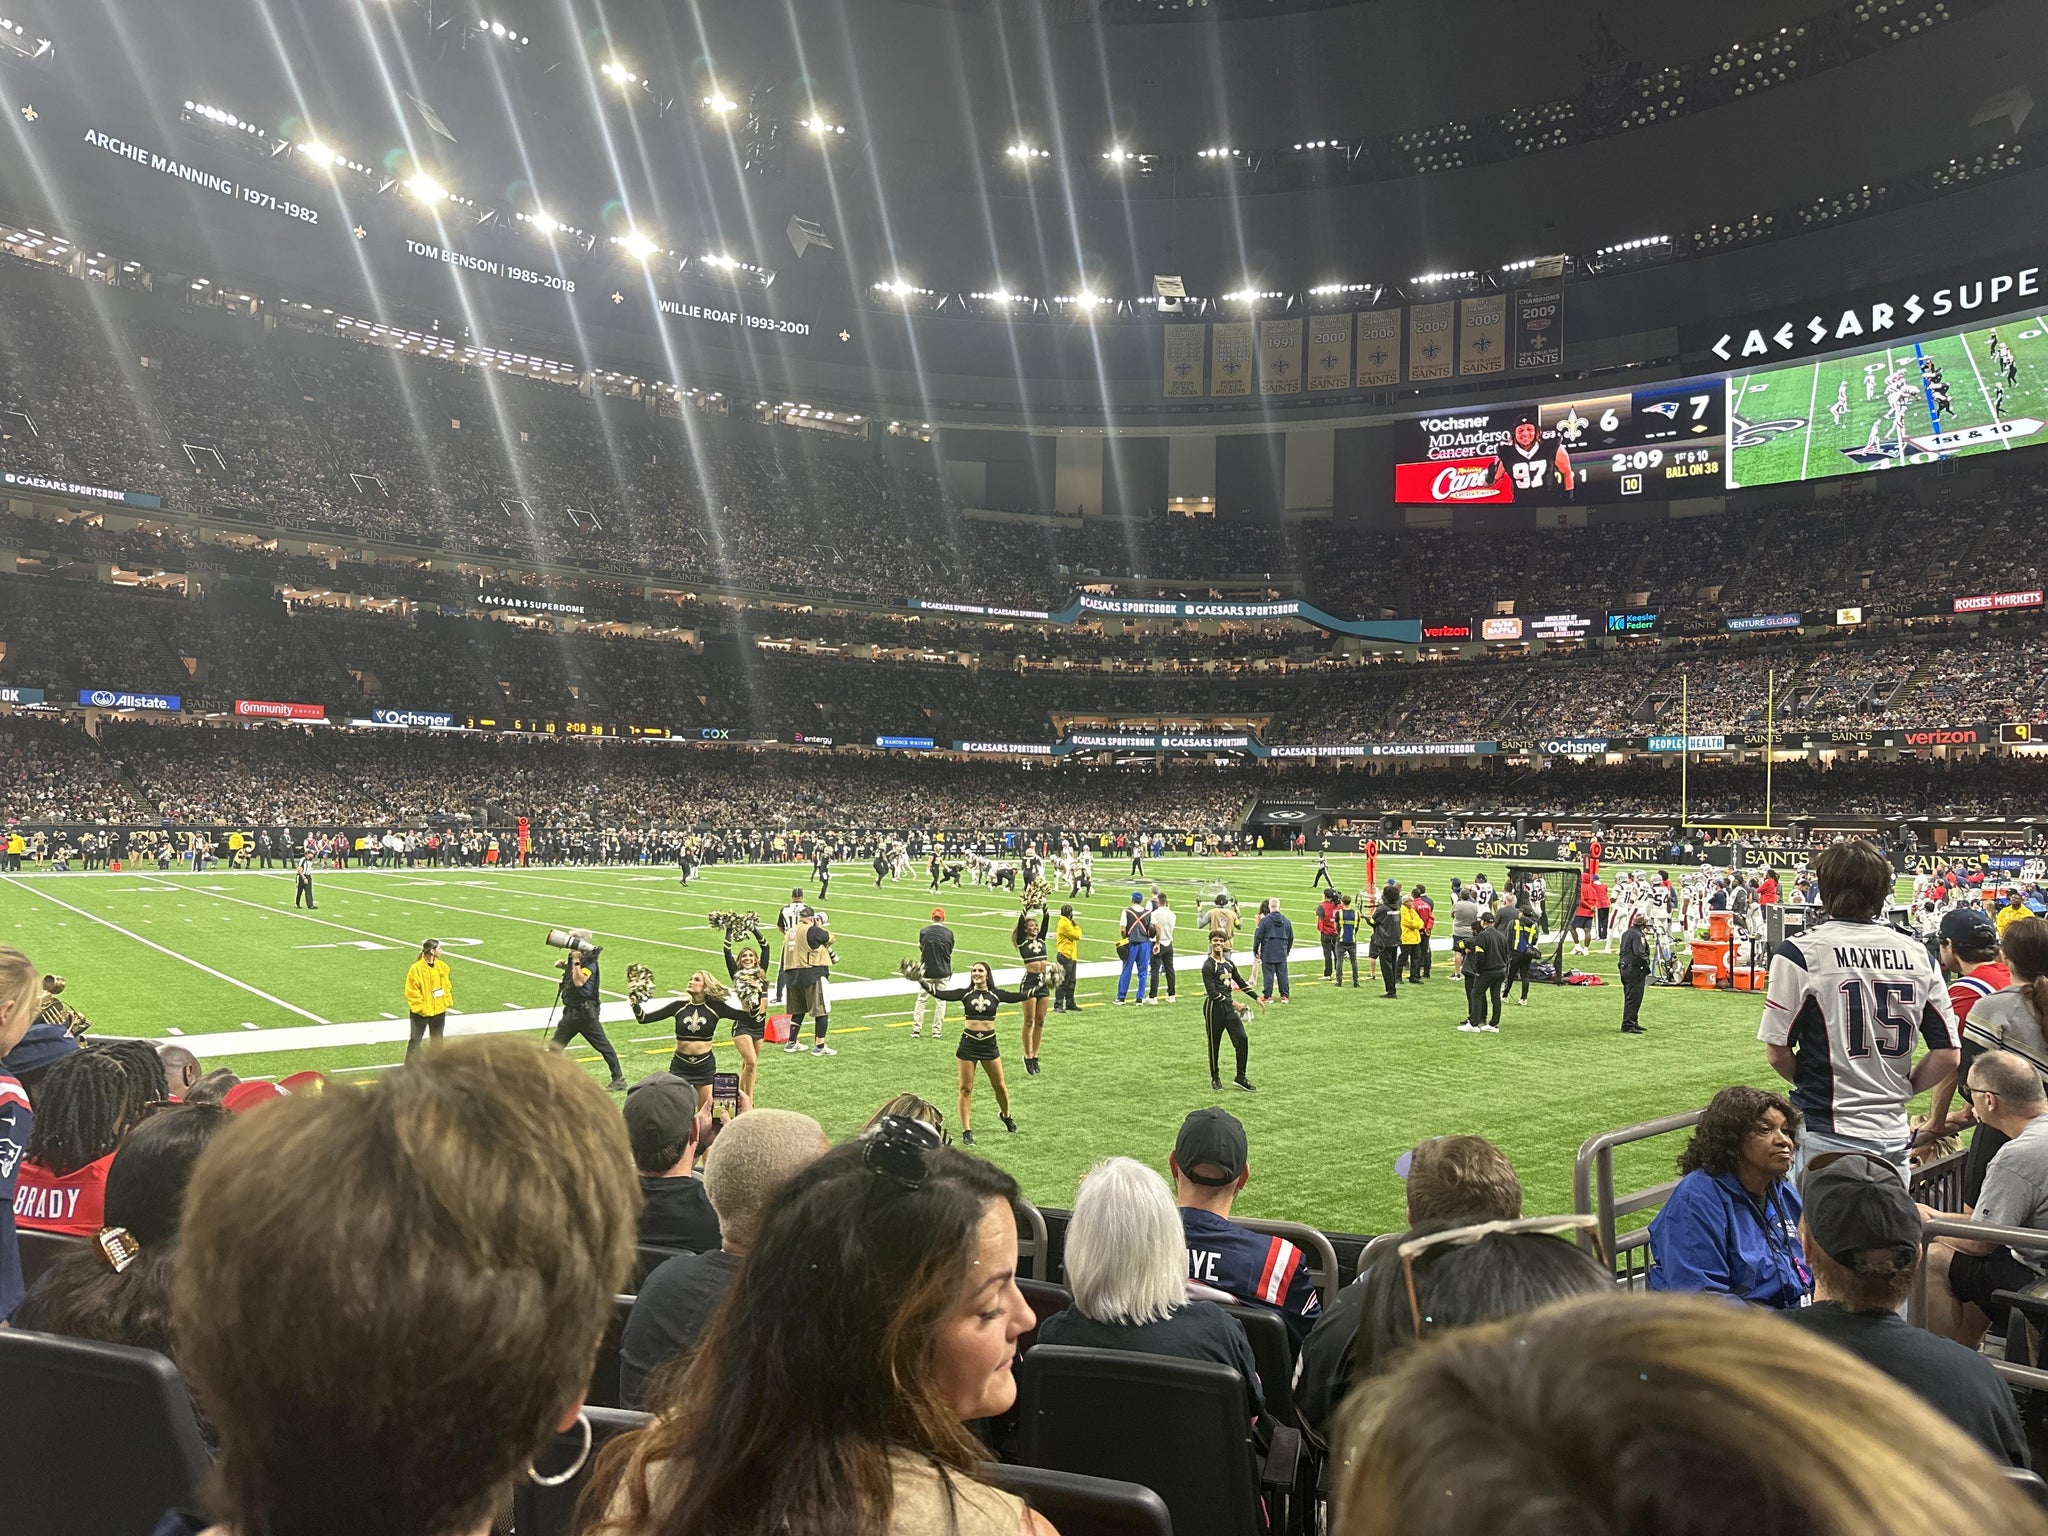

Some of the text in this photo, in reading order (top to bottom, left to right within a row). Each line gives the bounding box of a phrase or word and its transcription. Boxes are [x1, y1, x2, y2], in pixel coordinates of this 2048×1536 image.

[84, 128, 319, 225] ARCHIE MANNING 1971-1982
[406, 240, 576, 293] TOM BENSON 1985-2018
[1519, 294, 1560, 305] CHAMPIONS
[658, 299, 810, 336] WILLIE ROAF 1993-2001
[1522, 305, 1556, 319] 2009
[1711, 267, 2039, 361] CAESARS SUPE
[1416, 320, 1448, 333] 2009
[1467, 313, 1500, 327] 2009
[1314, 332, 1346, 344] 2000
[1363, 328, 1395, 340] 2006
[1268, 337, 1295, 349] 1991
[1518, 353, 1559, 367] SAINTS
[1412, 367, 1450, 379] SAINTS
[1462, 361, 1502, 374] SAINTS
[1310, 378, 1347, 389] SAINTS
[1360, 374, 1397, 386] SAINTS
[1262, 383, 1299, 393] SAINTS
[1690, 395, 1710, 420] 7
[1429, 416, 1490, 431] Ochsner
[1600, 408, 1619, 432] 6
[1429, 430, 1511, 448] MD Anderso
[1931, 424, 2012, 445] 1st & 10
[1427, 446, 1475, 460] Cancer
[1674, 450, 1709, 464] 1ST & 10
[1611, 449, 1664, 472] 2:09
[1512, 459, 1547, 489] 97
[1665, 462, 1719, 479] BALL ON 38
[16, 475, 125, 501] CAESARS SPORTSBOOK
[1625, 479, 1638, 490] 10
[167, 500, 214, 515] SAINTS
[266, 515, 309, 529] SAINTS
[356, 528, 396, 541] SAINTS
[442, 540, 479, 553] SAINTS
[82, 547, 128, 561] SAINTS
[521, 552, 557, 564] SAINTS
[185, 561, 227, 573] SAINTS
[599, 563, 633, 574] SAINTS
[277, 571, 316, 583] SAINTS
[671, 572, 703, 583] SAINTS
[360, 581, 397, 593] SAINTS
[740, 581, 770, 591] SAINTS
[441, 591, 475, 601] SAINTS
[804, 588, 833, 599] SAINTS
[866, 595, 895, 605] SAINTS
[477, 594, 585, 614] CAESARS SUPERDOME
[927, 602, 953, 611] CAESARS
[1085, 598, 1177, 614] CAESARS SPORTSBOOK
[1955, 592, 2041, 610] ROUSES MARKETS
[993, 608, 1019, 617] CAESARS
[1195, 603, 1299, 616] CAESARS SPORTSBOOK
[1873, 604, 1912, 615] SAINTS
[1626, 614, 1656, 622] Keesler
[1727, 616, 1799, 629] VENTURE GLOBAL
[1423, 625, 1469, 638] verizon
[1626, 622, 1654, 630] Feder
[1683, 621, 1717, 631] SAINTS
[185, 699, 229, 710] SAINTS
[240, 701, 293, 717] Community
[386, 710, 450, 727] Ochsner
[702, 728, 729, 739] COX
[750, 732, 779, 740] SAINTS
[1743, 734, 1782, 744] SAINTS
[1831, 731, 1873, 742] SAINTS
[1904, 729, 1977, 745] verizon
[804, 736, 832, 745] entergy
[1077, 736, 1155, 747] CAESARS SPORTSBOOK
[1170, 738, 1212, 747] CAESARS
[1501, 739, 1534, 749] SAINTS
[1548, 740, 1607, 754] Ochsner
[1650, 738, 1723, 749] PEOPLES HEALTH
[970, 743, 1051, 754] CAESARS SPORTSBOOK
[1278, 746, 1364, 756] CAESARS SPORTSBOOK
[1382, 744, 1475, 755] CAESARS SPORTSBOOK
[1358, 838, 1407, 852] SINTS
[1475, 842, 1529, 856] SAINTS
[1745, 850, 1810, 865] SAINTS
[1833, 947, 1914, 971] MAXWELL
[1839, 978, 1917, 1060] 15
[12, 1185, 80, 1219] BRADY
